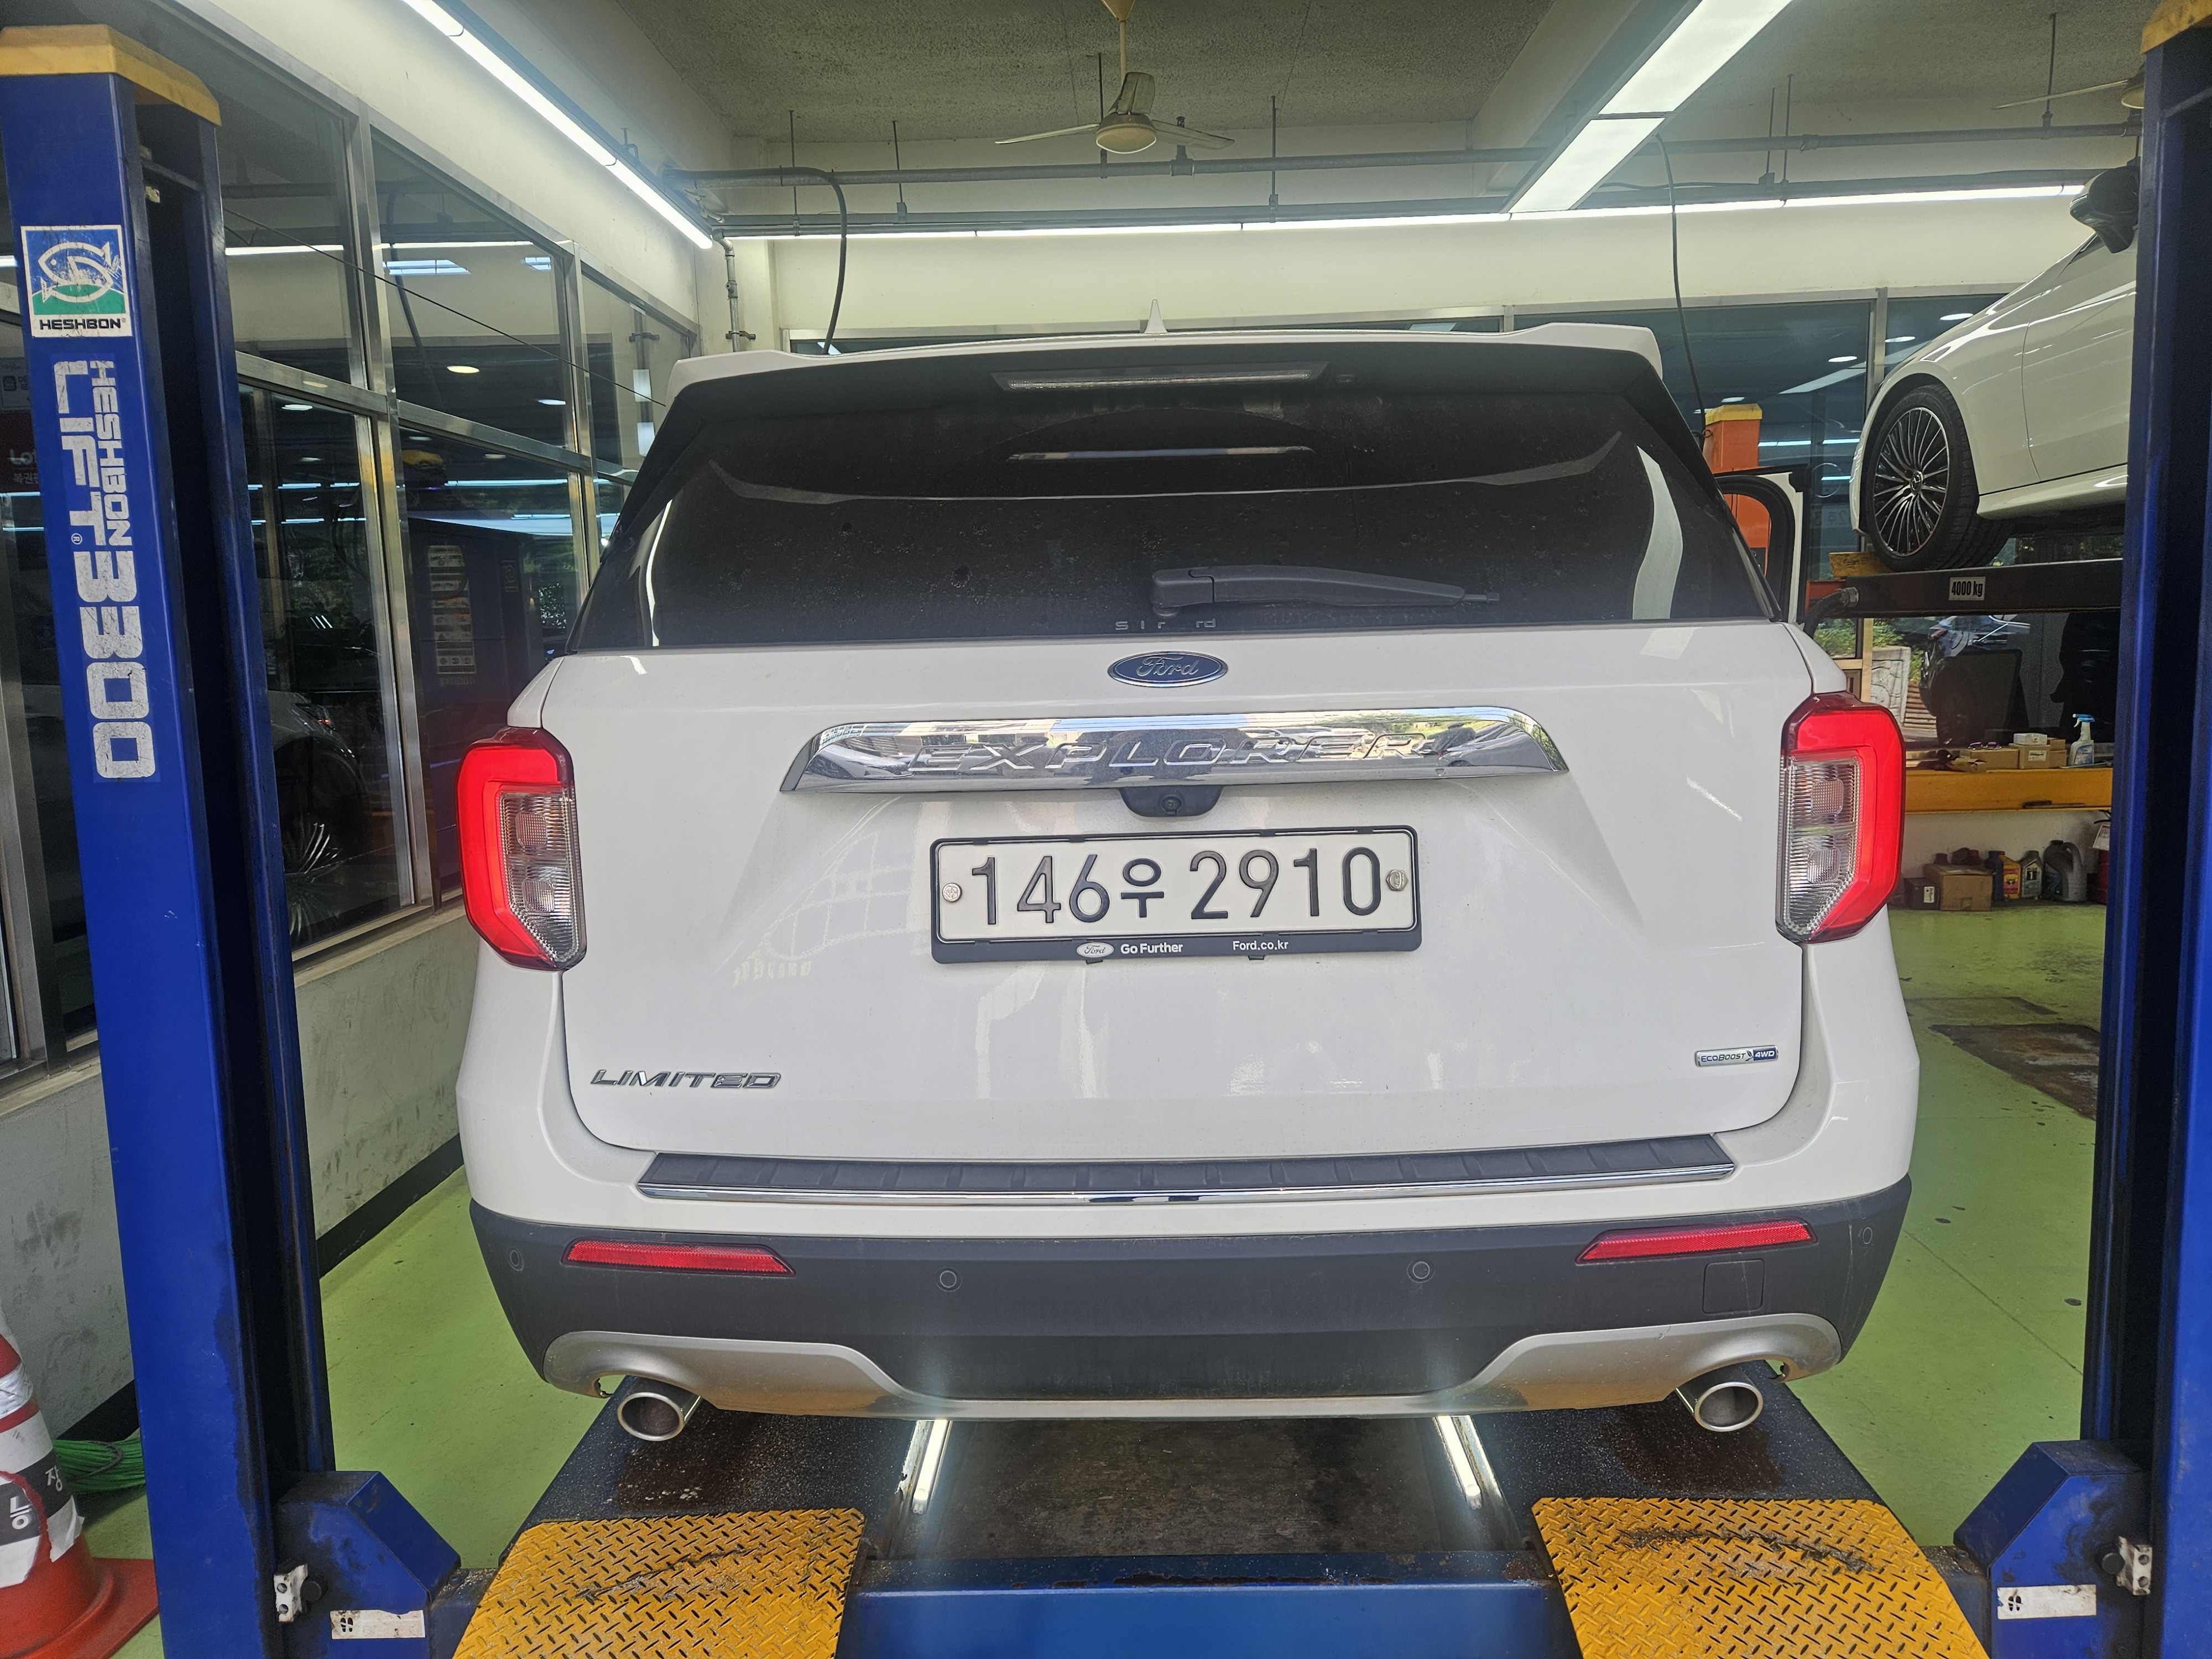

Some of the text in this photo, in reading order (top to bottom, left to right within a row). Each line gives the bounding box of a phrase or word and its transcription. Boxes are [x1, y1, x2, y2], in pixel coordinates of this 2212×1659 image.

[40, 318, 121, 330] HESHBON
[90, 361, 133, 546] HESHBON
[1951, 581, 1983, 597] 4000 kg
[73, 551, 156, 779] 3300
[1135, 656, 1200, 677] Ford
[907, 733, 1436, 772] EXPLORER
[971, 847, 1381, 926] 146우 2910
[1084, 942, 1183, 955] Ford Go Further
[1232, 940, 1289, 951] Ford.co.kr
[589, 1069, 781, 1089] LIMITED
[45, 1465, 62, 1492] 장
[10, 1495, 32, 1530] 능
